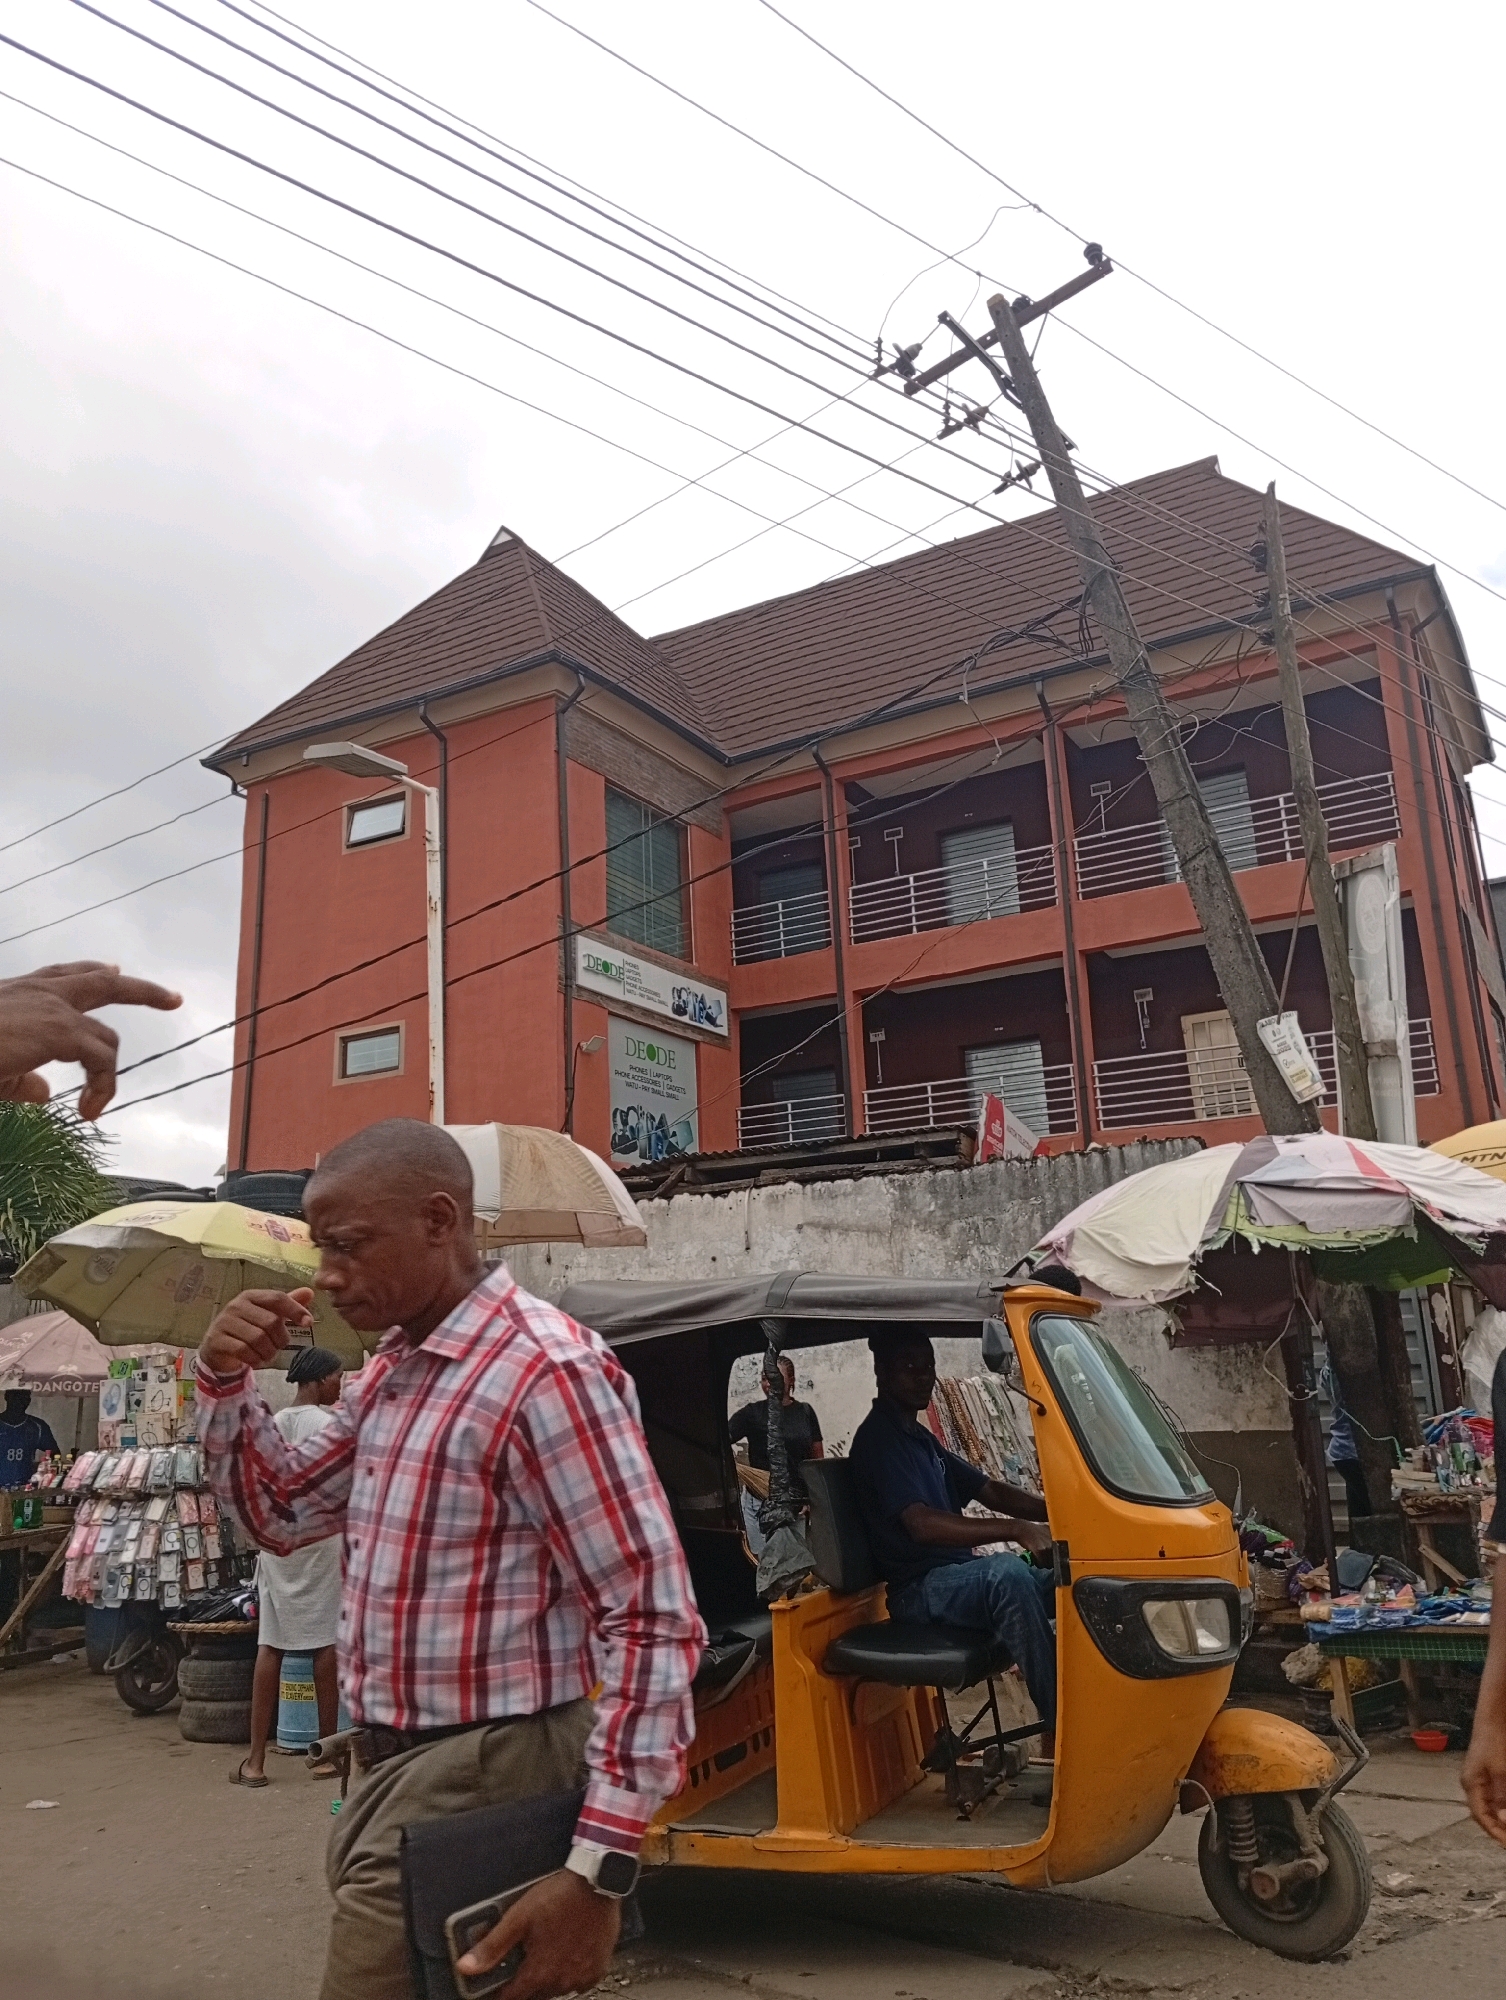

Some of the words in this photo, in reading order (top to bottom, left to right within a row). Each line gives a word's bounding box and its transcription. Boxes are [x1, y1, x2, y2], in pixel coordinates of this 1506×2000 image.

[625, 960, 640, 970] PHONES
[625, 968, 642, 977] LAPTOPS
[625, 974, 642, 984] GADGETS
[626, 981, 637, 989] PHONE
[629, 1064, 648, 1075] PHONES
[653, 1072, 673, 1082] LAPTOPS
[615, 1069, 630, 1079] PHONE
[632, 1074, 661, 1088] ACCESSORIES
[666, 1083, 686, 1094] GADGETS
[625, 1080, 639, 1090] WATU
[651, 1088, 665, 1098] SMALL
[666, 1092, 679, 1100] SMALL
[1461, 1152, 1506, 1163] MTN
[32, 1381, 100, 1393] DANGOTE
[7, 1448, 23, 1461] 88
